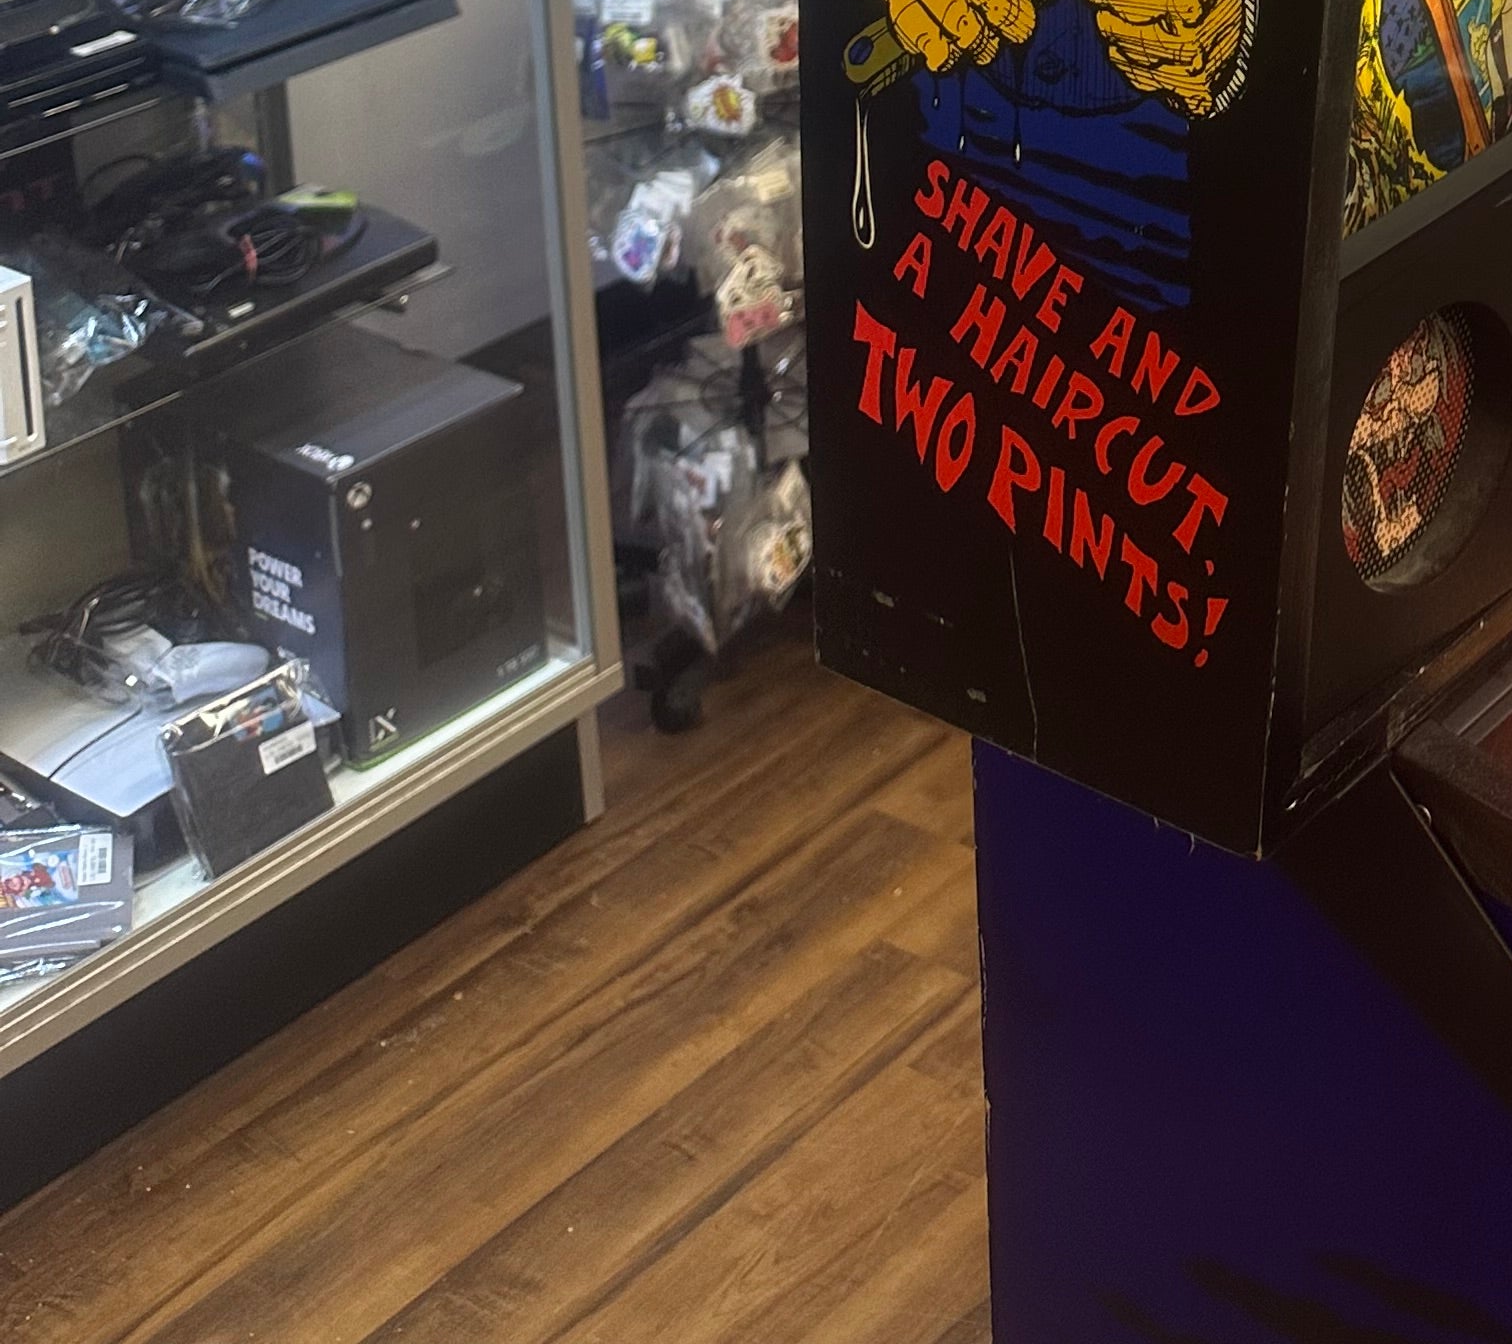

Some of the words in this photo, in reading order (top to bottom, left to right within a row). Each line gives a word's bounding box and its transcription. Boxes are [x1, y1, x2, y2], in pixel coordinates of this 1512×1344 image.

[893, 232, 933, 299] A
[914, 160, 1085, 332] SHAVE
[1090, 306, 1221, 416] AND
[853, 299, 976, 493] TWO
[987, 424, 1229, 668] PINTS!
[248, 547, 304, 588] POWER
[251, 569, 291, 604] YOUR
[252, 590, 316, 636] DREAMS
